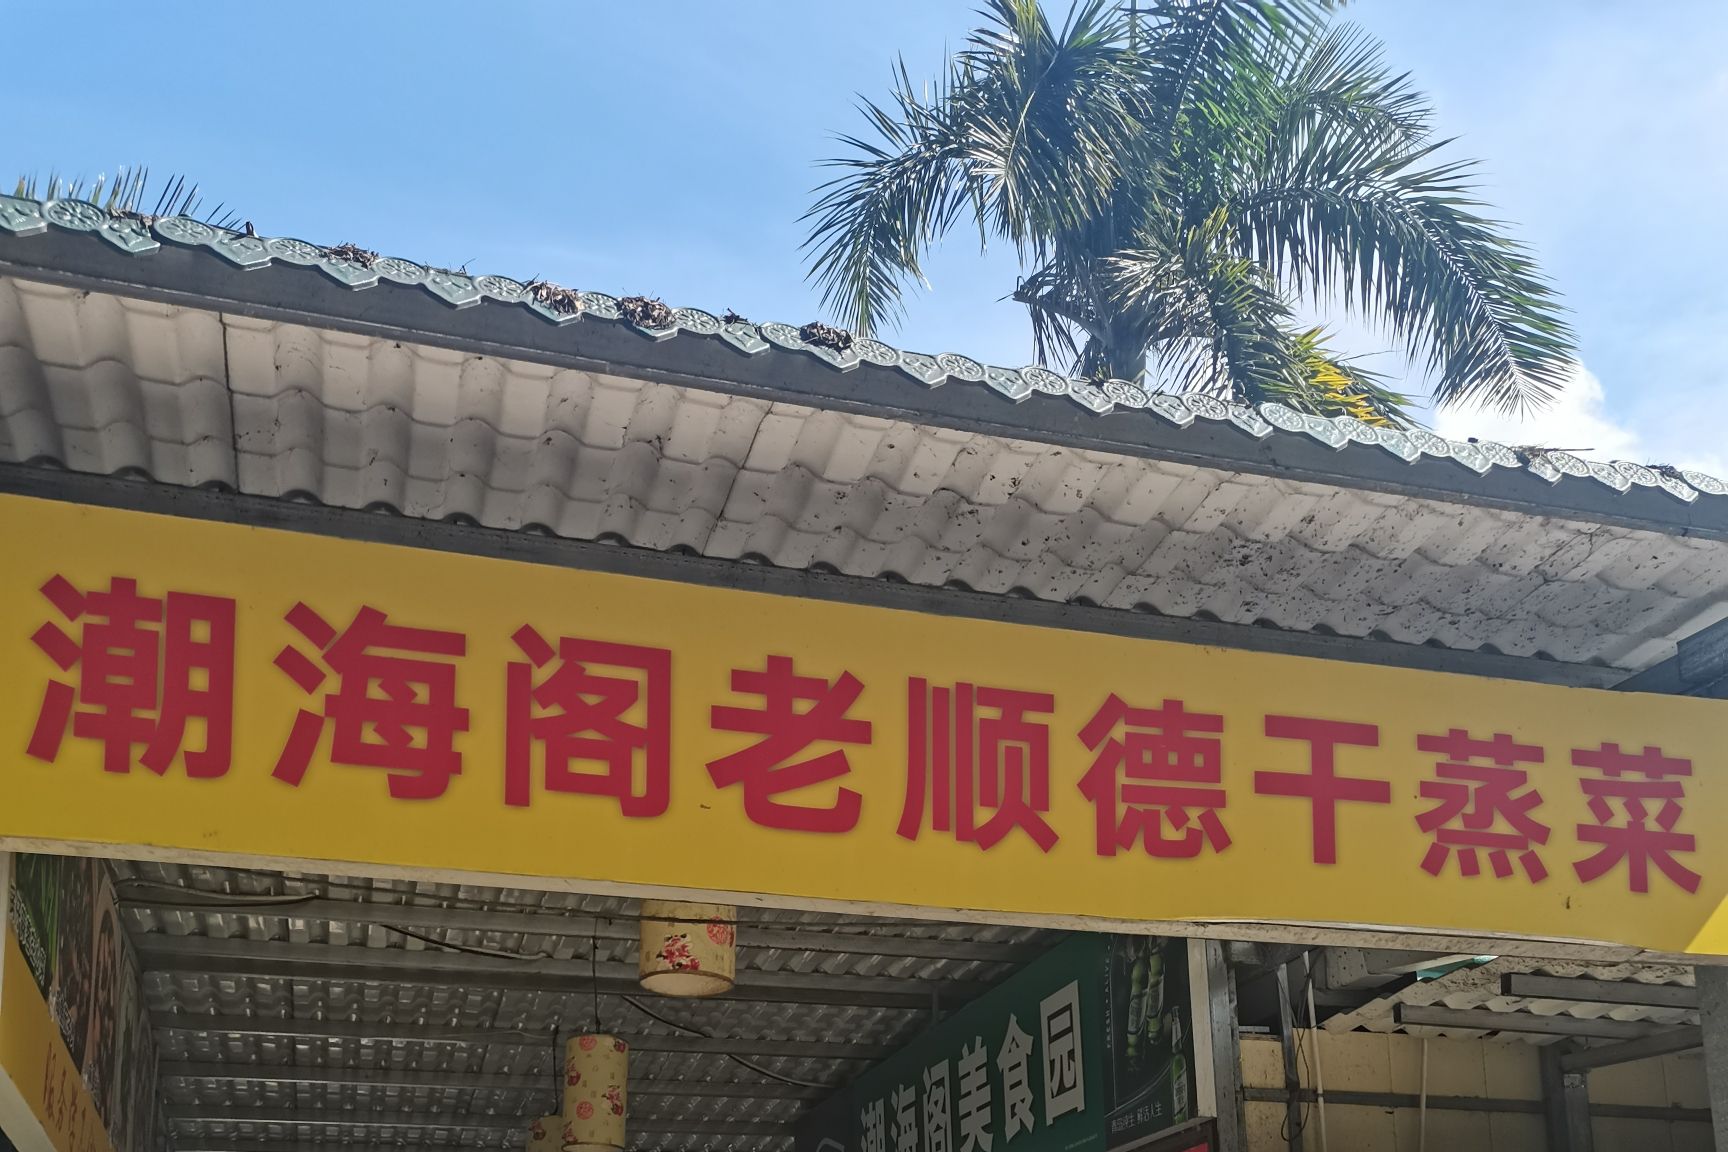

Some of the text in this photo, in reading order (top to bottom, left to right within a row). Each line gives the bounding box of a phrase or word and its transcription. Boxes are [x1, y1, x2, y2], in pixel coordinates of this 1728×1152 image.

[26, 573, 1703, 895] 潮海阁老顺德干蒸菜
